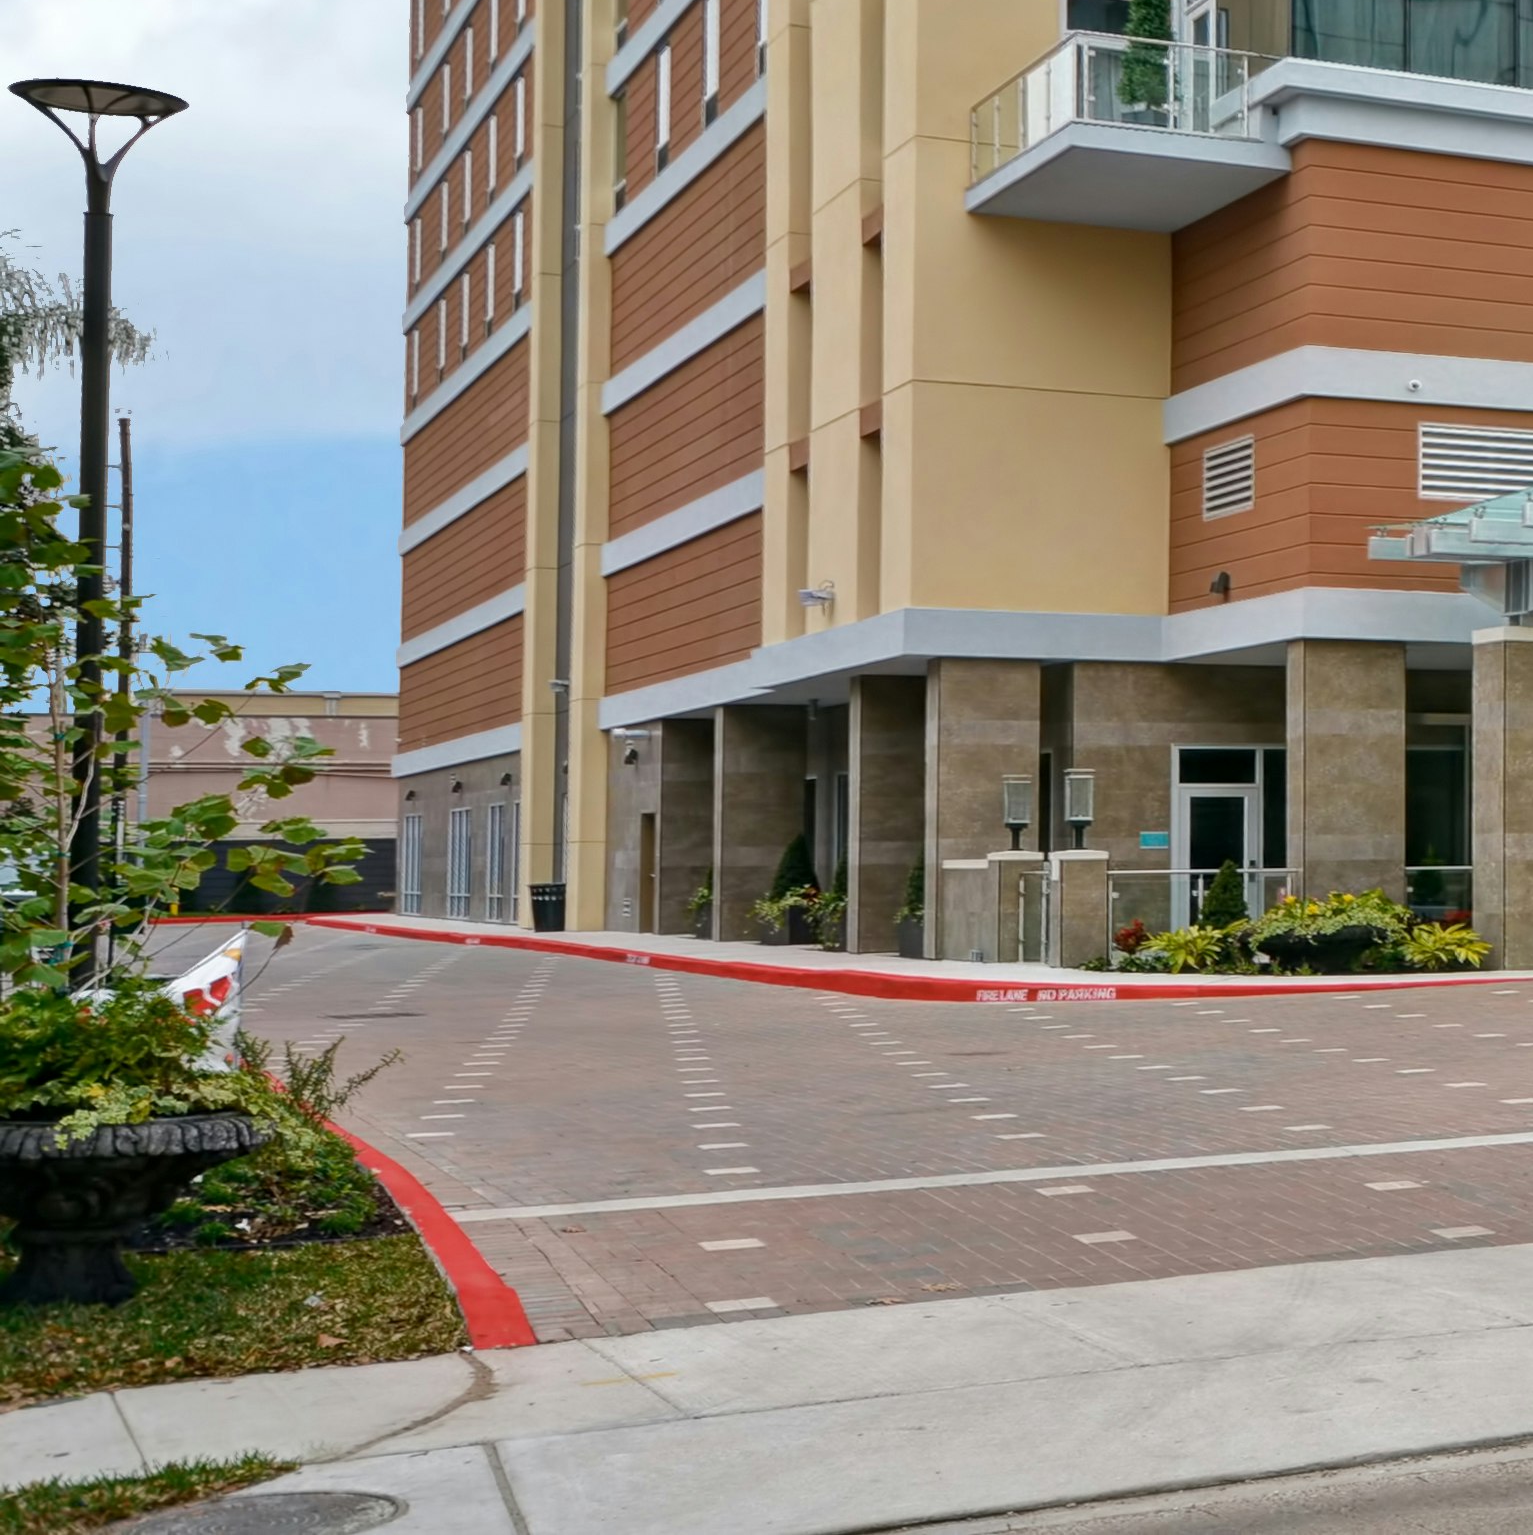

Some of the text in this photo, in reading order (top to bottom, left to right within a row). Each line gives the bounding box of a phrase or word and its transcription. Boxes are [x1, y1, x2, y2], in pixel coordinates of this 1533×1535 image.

[976, 987, 1117, 1001] FIRE LANE NO PARKING
